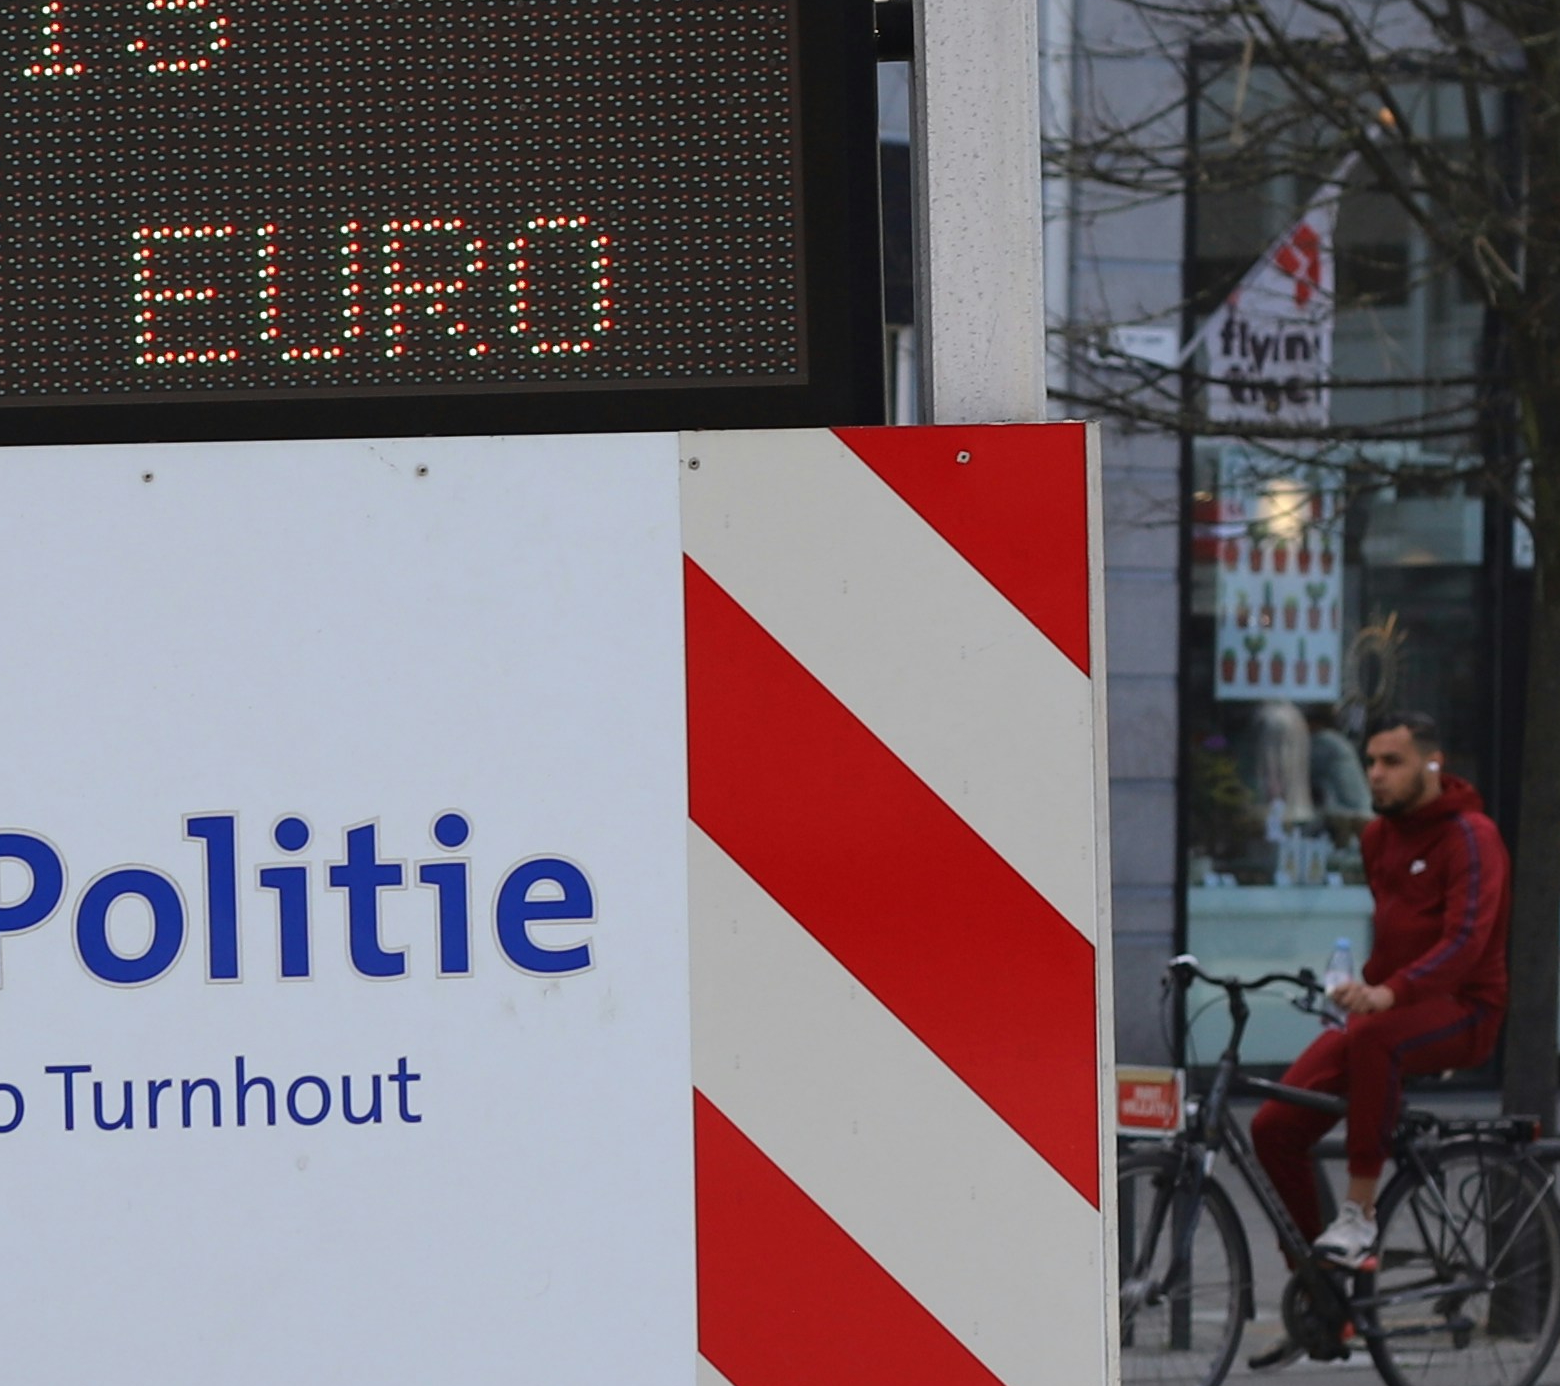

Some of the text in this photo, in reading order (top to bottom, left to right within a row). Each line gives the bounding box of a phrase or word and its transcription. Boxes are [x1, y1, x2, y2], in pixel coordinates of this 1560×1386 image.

[132, 214, 614, 365] EURO
[1221, 313, 1321, 370] flyin
[46, 1057, 422, 1130] Turnhout
